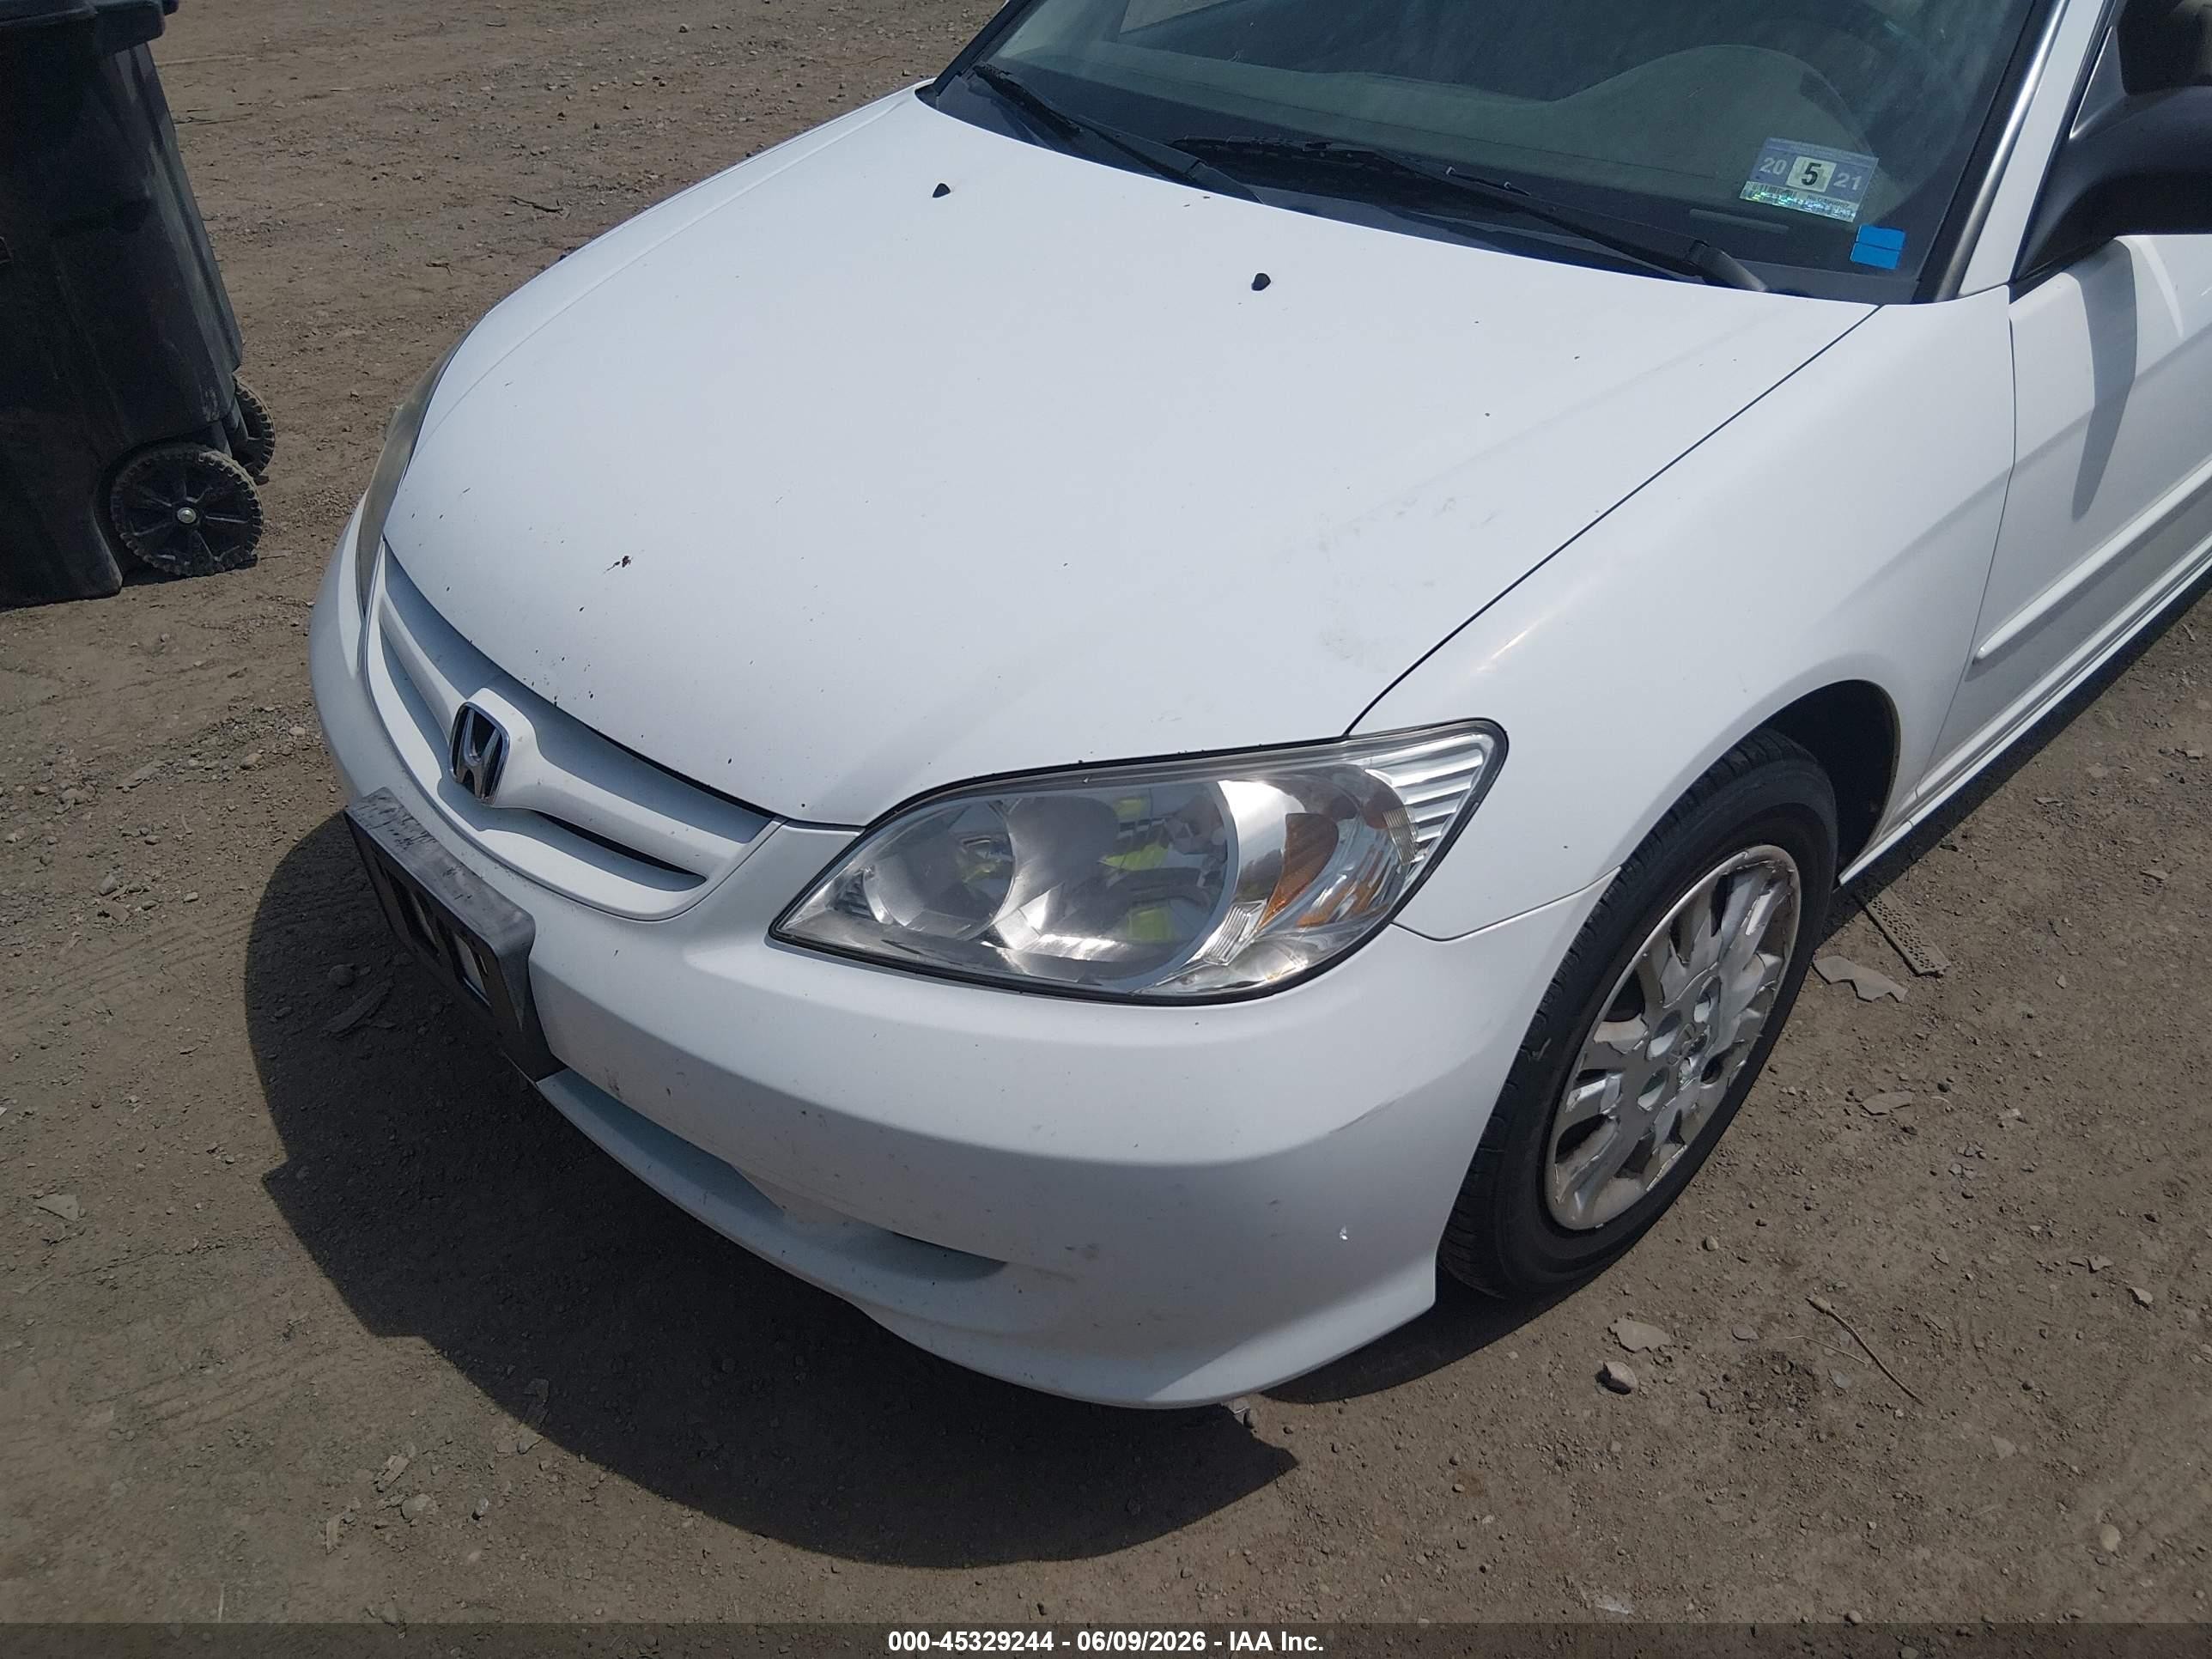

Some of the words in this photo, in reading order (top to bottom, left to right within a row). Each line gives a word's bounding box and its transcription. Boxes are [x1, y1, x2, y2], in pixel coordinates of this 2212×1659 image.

[1759, 157, 1787, 176] 20
[1801, 162, 1822, 186] 5
[1833, 172, 1863, 191] 21
